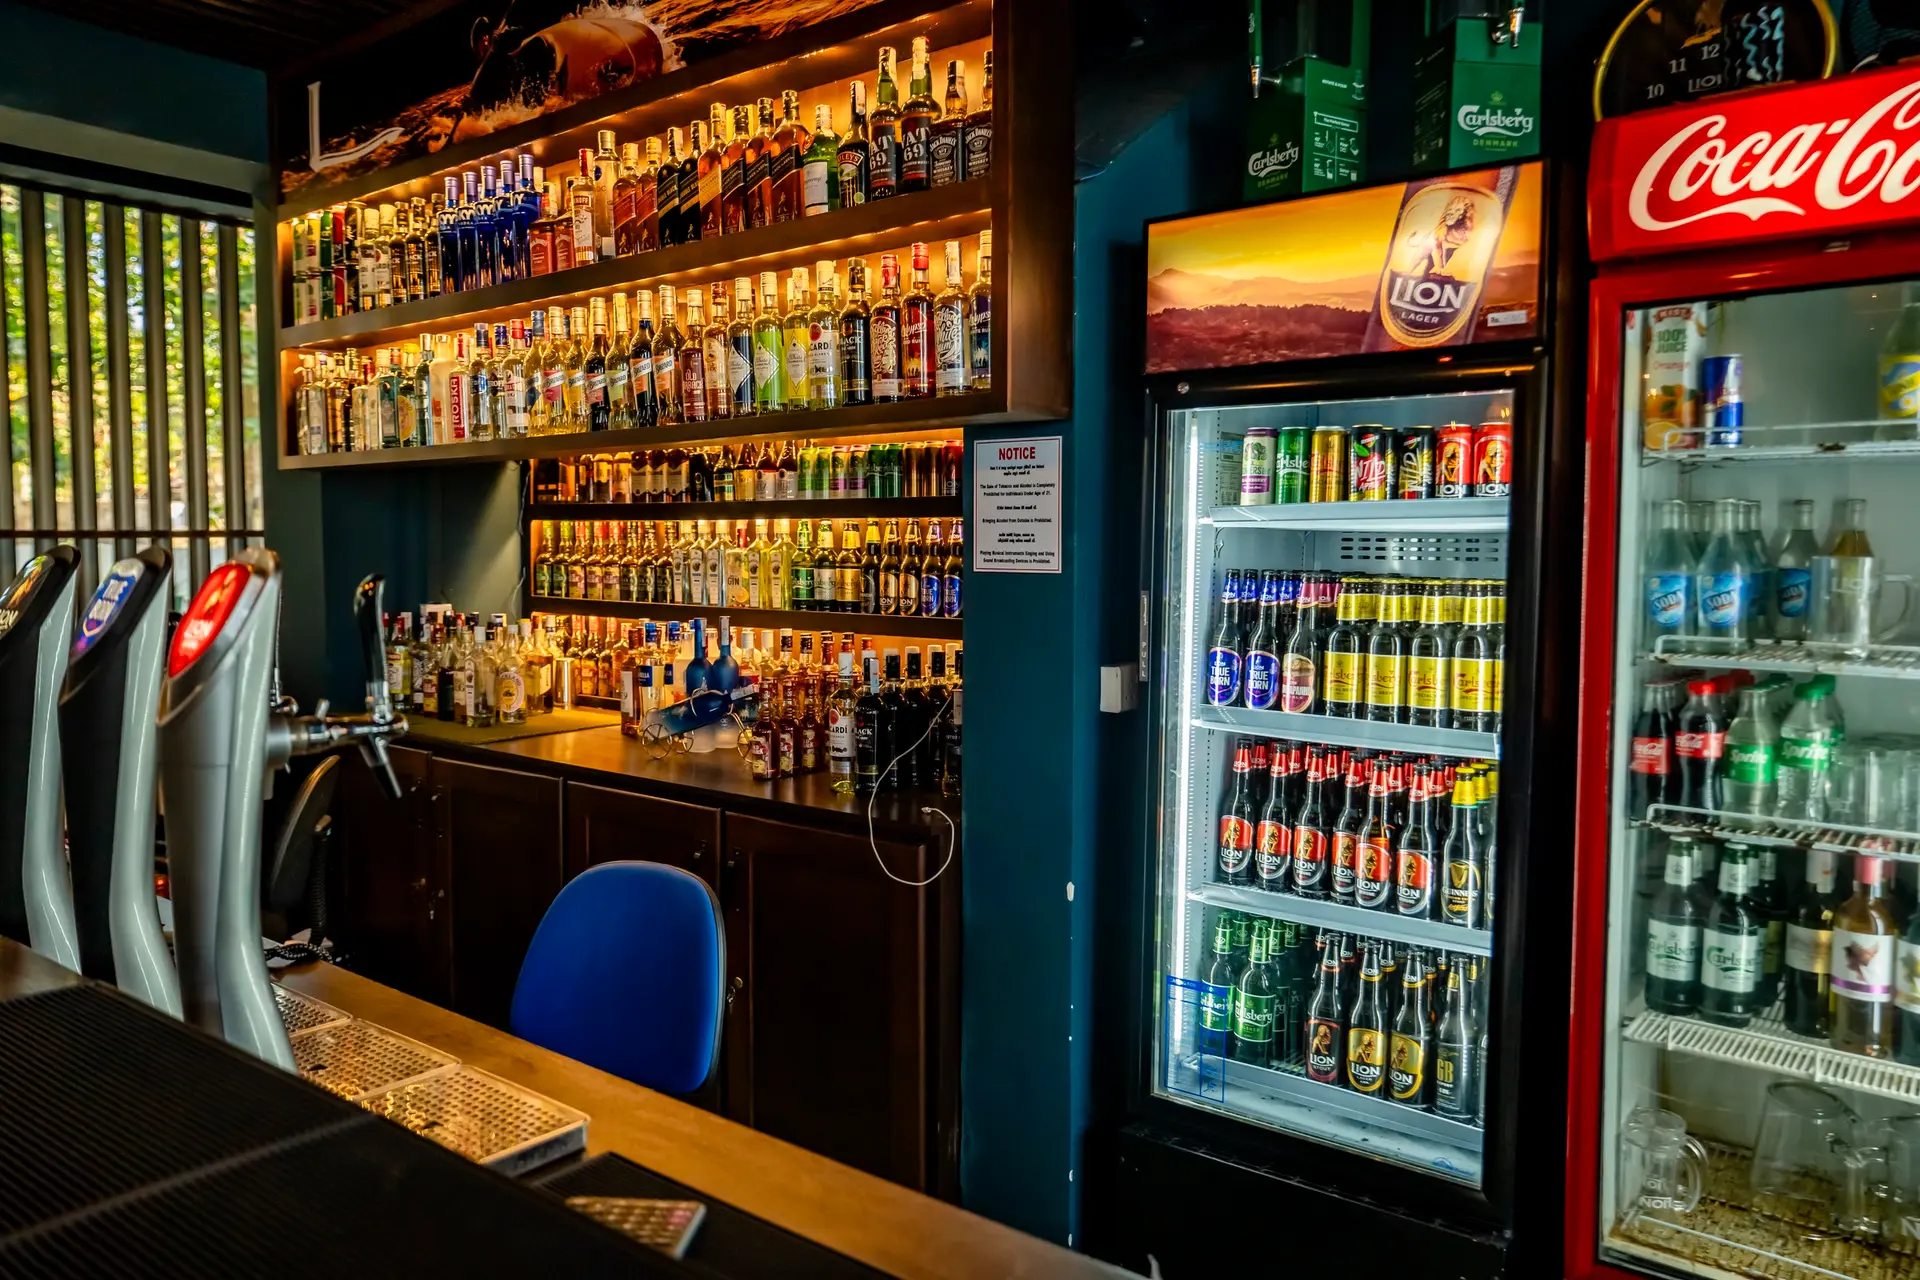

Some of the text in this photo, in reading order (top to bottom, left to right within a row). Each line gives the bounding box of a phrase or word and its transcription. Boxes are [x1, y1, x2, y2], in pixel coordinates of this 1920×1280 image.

[1701, 43, 1720, 60] 12
[1668, 58, 1687, 74] 11
[1647, 83, 1665, 99] 10
[1457, 105, 1534, 136] Carlsberg
[965, 128, 976, 143] JACK
[1472, 138, 1519, 147] DENMARK
[870, 135, 893, 154] AT
[929, 136, 957, 151] JACK DANIEL'S
[838, 152, 860, 164] ILEYS
[1248, 142, 1299, 178] Carlsberg
[1629, 78, 1920, 231] Coca-Co
[1389, 277, 1467, 313] LION
[1401, 311, 1440, 324] LAGER
[1657, 328, 1687, 343] 100%
[1656, 342, 1687, 354] JUICE
[998, 446, 1036, 460] NOTICE
[1353, 454, 1387, 483] WILD
[1435, 484, 1467, 498] LION
[1476, 483, 1510, 497] LION
[727, 577, 740, 586] GIN
[900, 598, 913, 607] ION
[0, 608, 19, 630] ION
[831, 724, 848, 734] ARDÍ
[1729, 748, 1769, 764] Sprite
[1782, 740, 1829, 761] Sprite
[1220, 847, 1243, 859] LION
[1258, 853, 1281, 864] LION
[1294, 858, 1316, 870] LION
[1333, 866, 1355, 878] LION
[1356, 878, 1381, 891] LION
[1396, 885, 1421, 898] LION
[1442, 886, 1478, 897] GUINNESS
[1309, 1053, 1336, 1066] LION
[1351, 1063, 1380, 1077] LION
[1436, 1058, 1453, 1082] GB
[1389, 1070, 1413, 1085] LION
